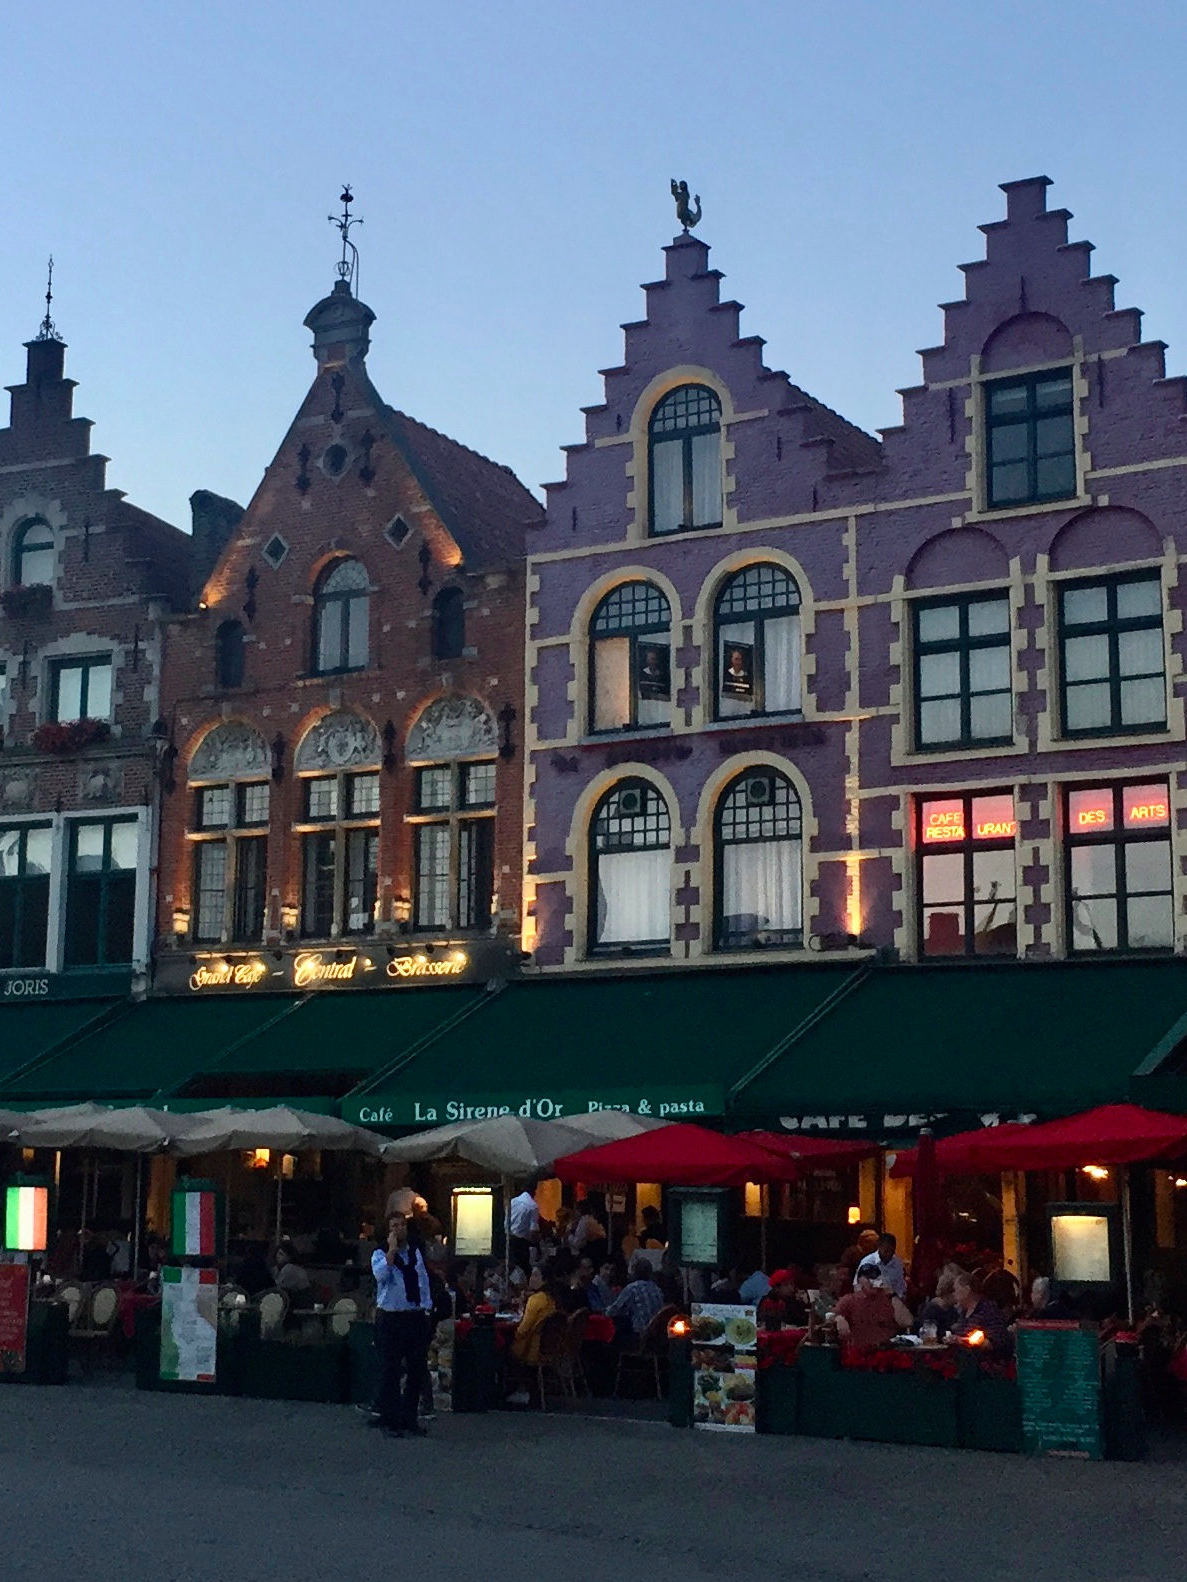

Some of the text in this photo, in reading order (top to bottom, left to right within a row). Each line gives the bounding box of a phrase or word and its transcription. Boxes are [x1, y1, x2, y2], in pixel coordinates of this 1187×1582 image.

[929, 811, 962, 826] CAFE
[1078, 803, 1167, 825] DES ARTS
[925, 825, 966, 839] RESTA
[294, 953, 357, 986] Central
[4, 979, 49, 996] JORIS
[359, 1107, 393, 1122] Café
[414, 1102, 438, 1121] La
[518, 1098, 564, 1118] d'Or
[637, 1098, 652, 1114] &
[659, 1099, 706, 1117] pasta
